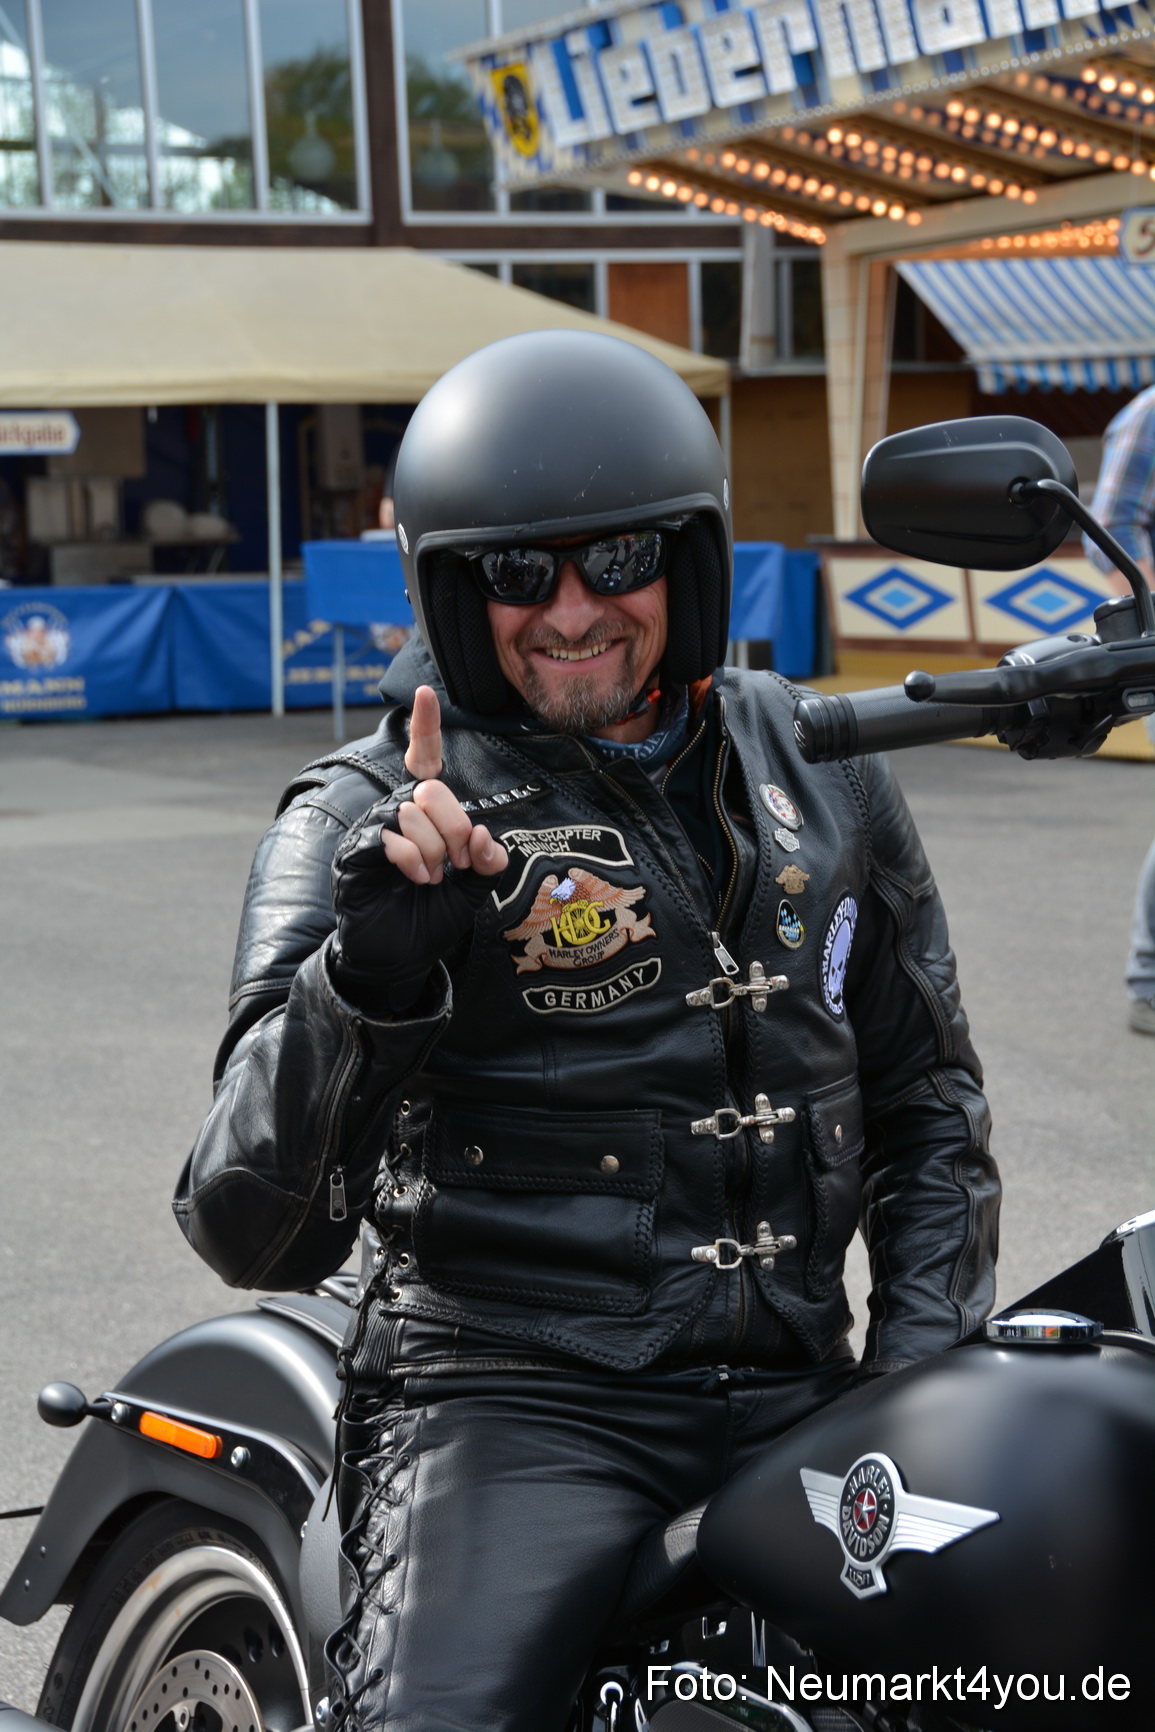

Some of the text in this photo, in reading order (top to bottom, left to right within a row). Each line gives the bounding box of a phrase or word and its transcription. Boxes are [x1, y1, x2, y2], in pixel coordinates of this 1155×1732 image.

[537, 829, 602, 842] CHAPTER
[548, 928, 620, 959] HARLEY OWNERS
[573, 950, 606, 967] GROUP
[544, 968, 645, 1009] GERMANY
[848, 1465, 892, 1501] HARLEY
[841, 1505, 890, 1557] DAVIDSON
